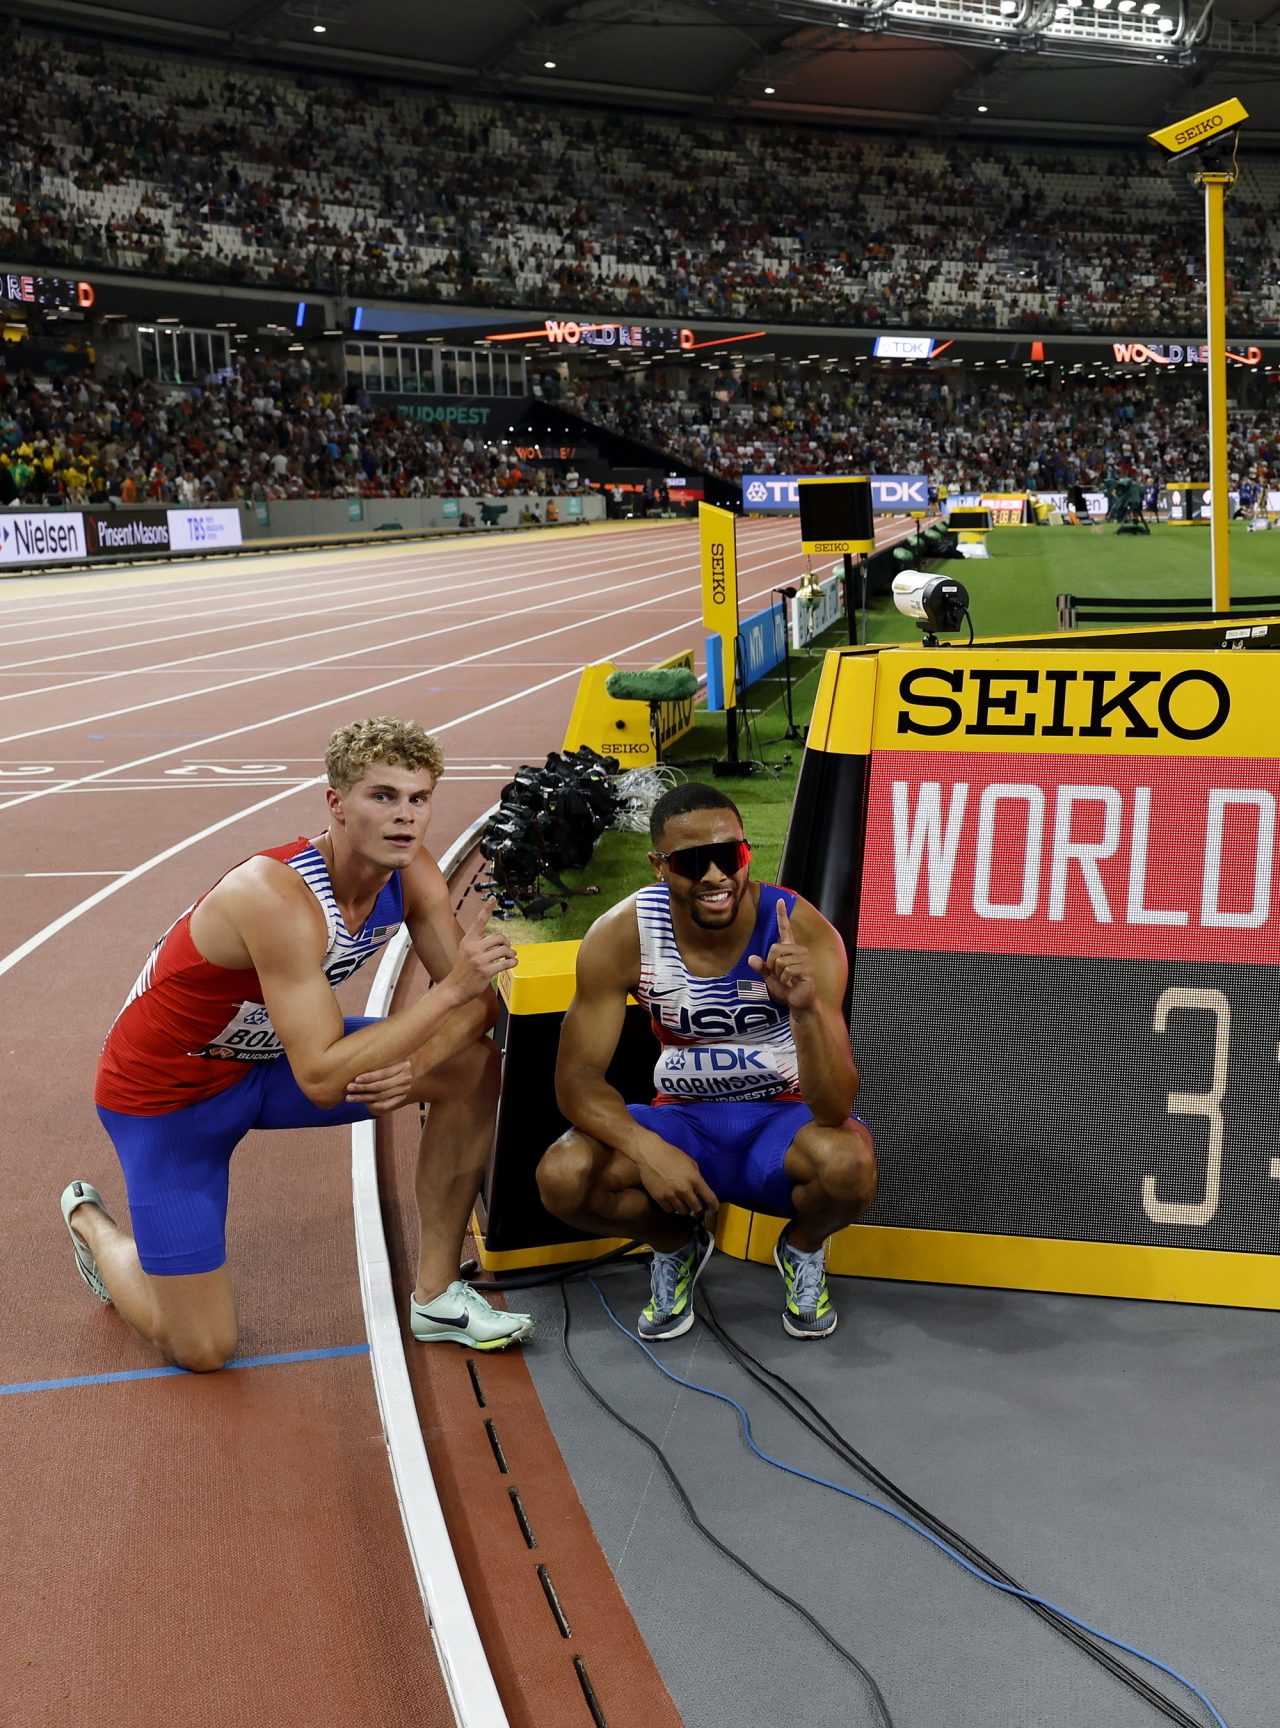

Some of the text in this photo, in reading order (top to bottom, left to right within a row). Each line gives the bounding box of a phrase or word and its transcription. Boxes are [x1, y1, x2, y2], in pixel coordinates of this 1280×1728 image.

[1175, 115, 1223, 145] SEIKO
[892, 342, 924, 353] TDK
[766, 482, 800, 502] TD
[14, 519, 78, 555] Nielsen
[98, 520, 169, 547] Pinsent Masons
[187, 517, 207, 541] TBS
[814, 542, 850, 552] SEIKO
[711, 543, 726, 605] SEIKO
[896, 667, 1231, 741] SEIKO
[601, 743, 650, 754] SEIKO
[890, 781, 1277, 929] WORLD
[650, 1002, 781, 1038] USA
[224, 1029, 282, 1047] BOL
[688, 1047, 767, 1071] TDK
[661, 1073, 779, 1094] ROBINSON
[770, 1086, 784, 1095] 23
